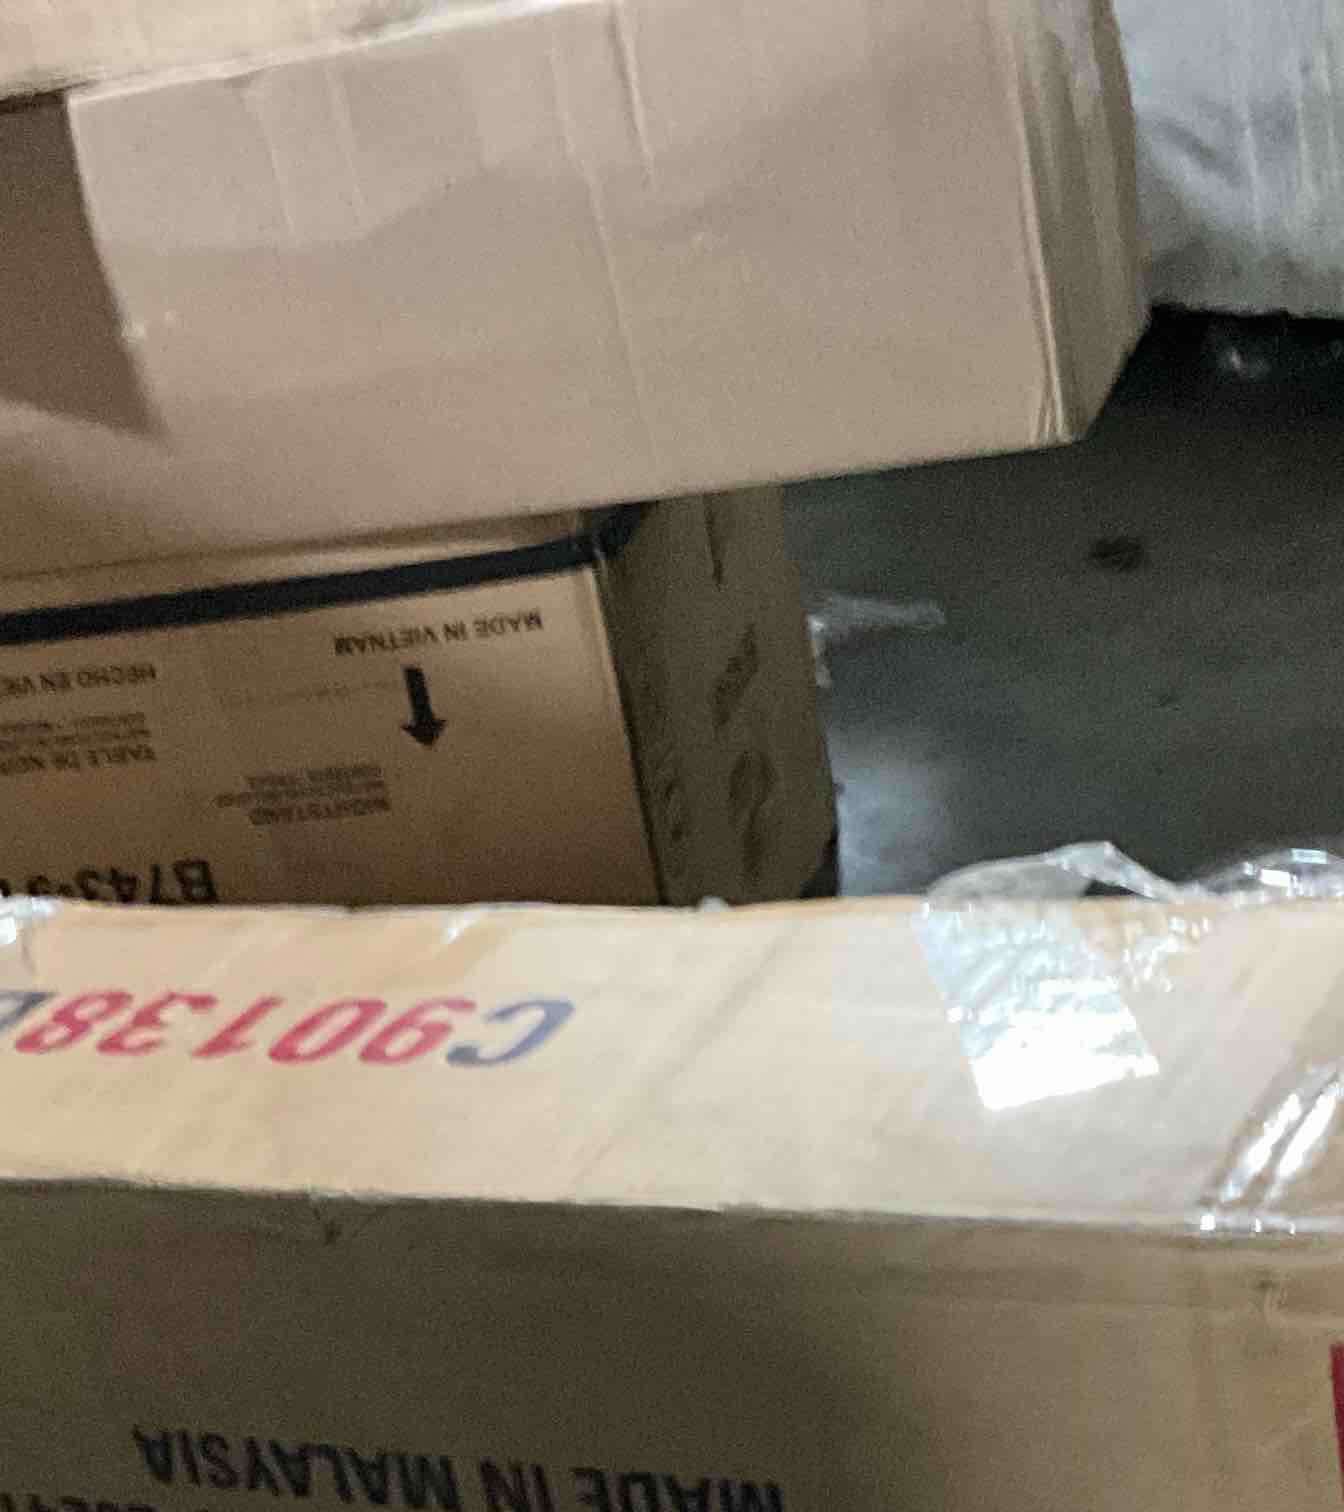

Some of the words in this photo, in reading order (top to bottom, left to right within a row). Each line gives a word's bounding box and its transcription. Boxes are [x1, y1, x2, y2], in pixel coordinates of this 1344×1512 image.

[437, 620, 467, 641] IN
[472, 606, 543, 637] MADE
[333, 625, 435, 657] VIETNAM
